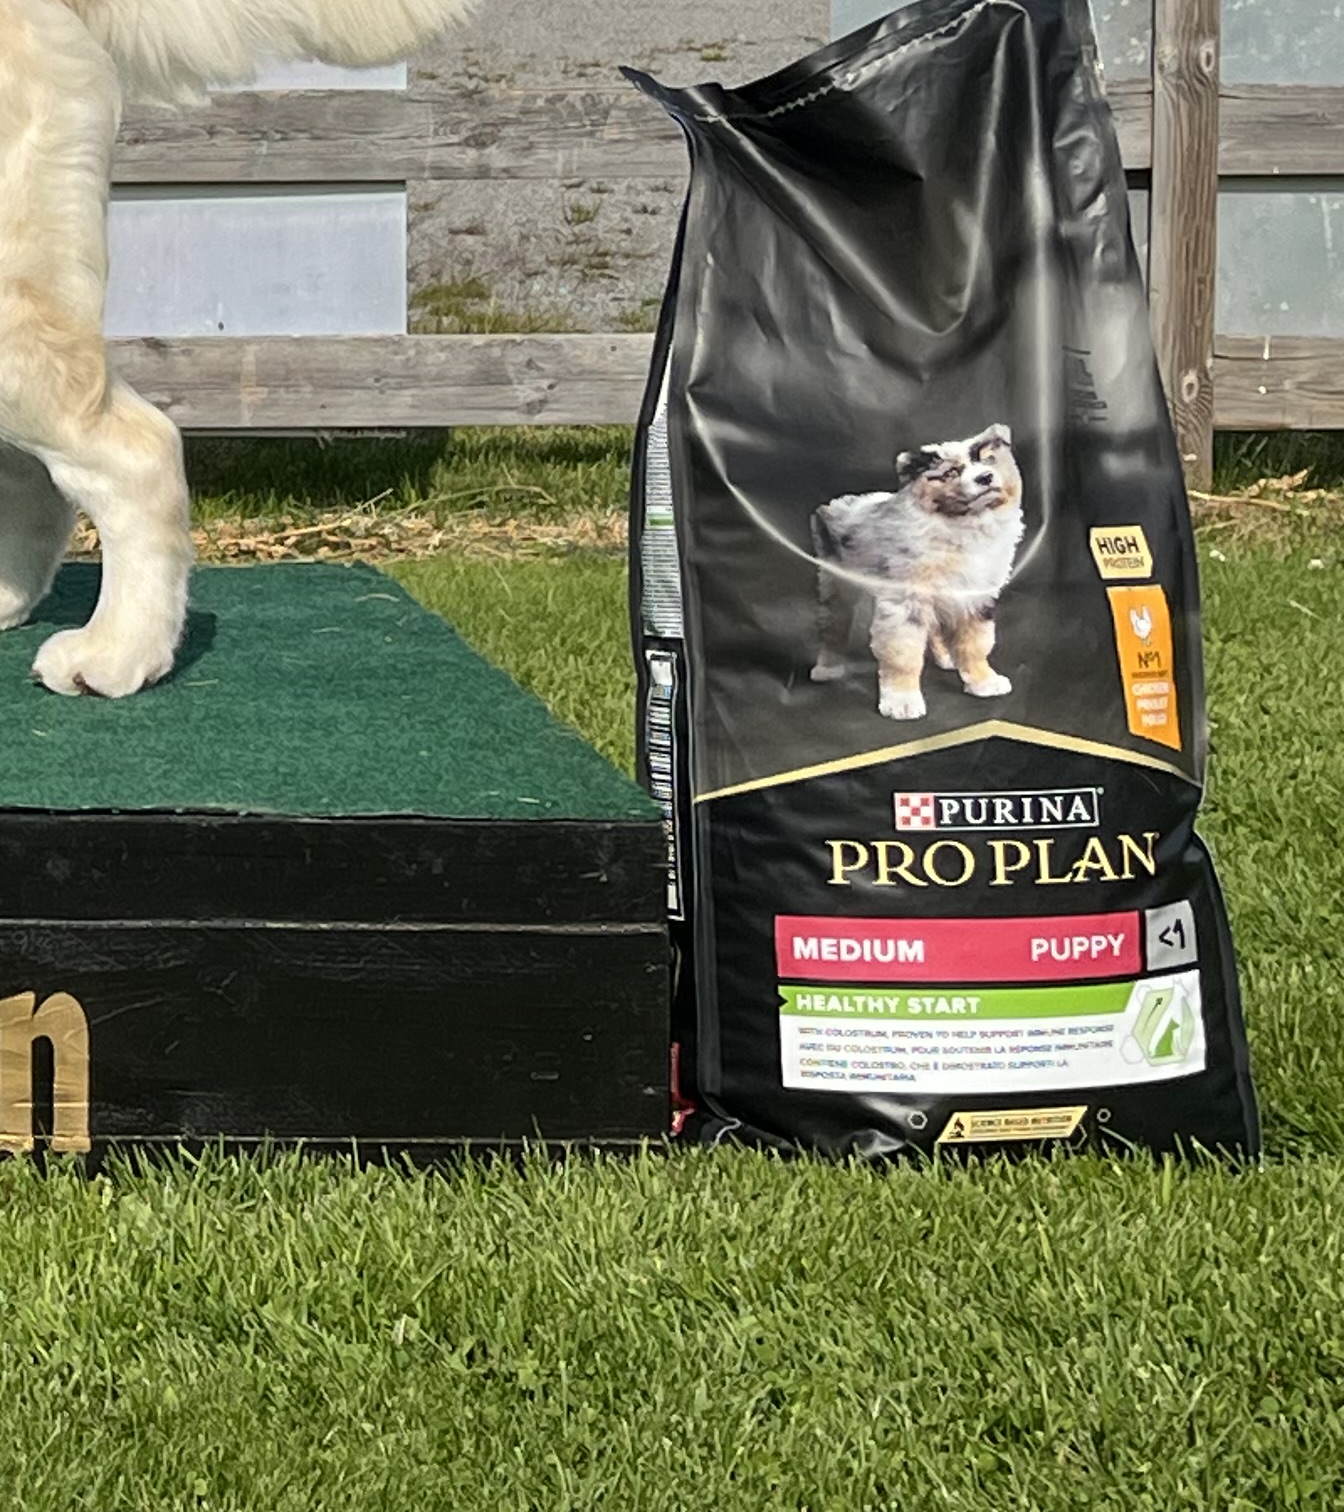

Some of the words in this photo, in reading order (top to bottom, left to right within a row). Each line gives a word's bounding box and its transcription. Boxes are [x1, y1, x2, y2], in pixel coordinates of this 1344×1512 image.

[1095, 535, 1140, 555] HIGH
[939, 794, 1091, 825] PURINA
[825, 839, 975, 887] PRO
[987, 832, 1157, 886] PLAN
[792, 936, 925, 963] MEDIUM
[1030, 933, 1125, 962] PUPPY
[796, 993, 900, 1014] HEALTHY
[908, 995, 981, 1015] START
[936, 1031, 950, 1039] TO
[952, 1030, 976, 1039] HELP
[994, 1046, 1007, 1054] LA
